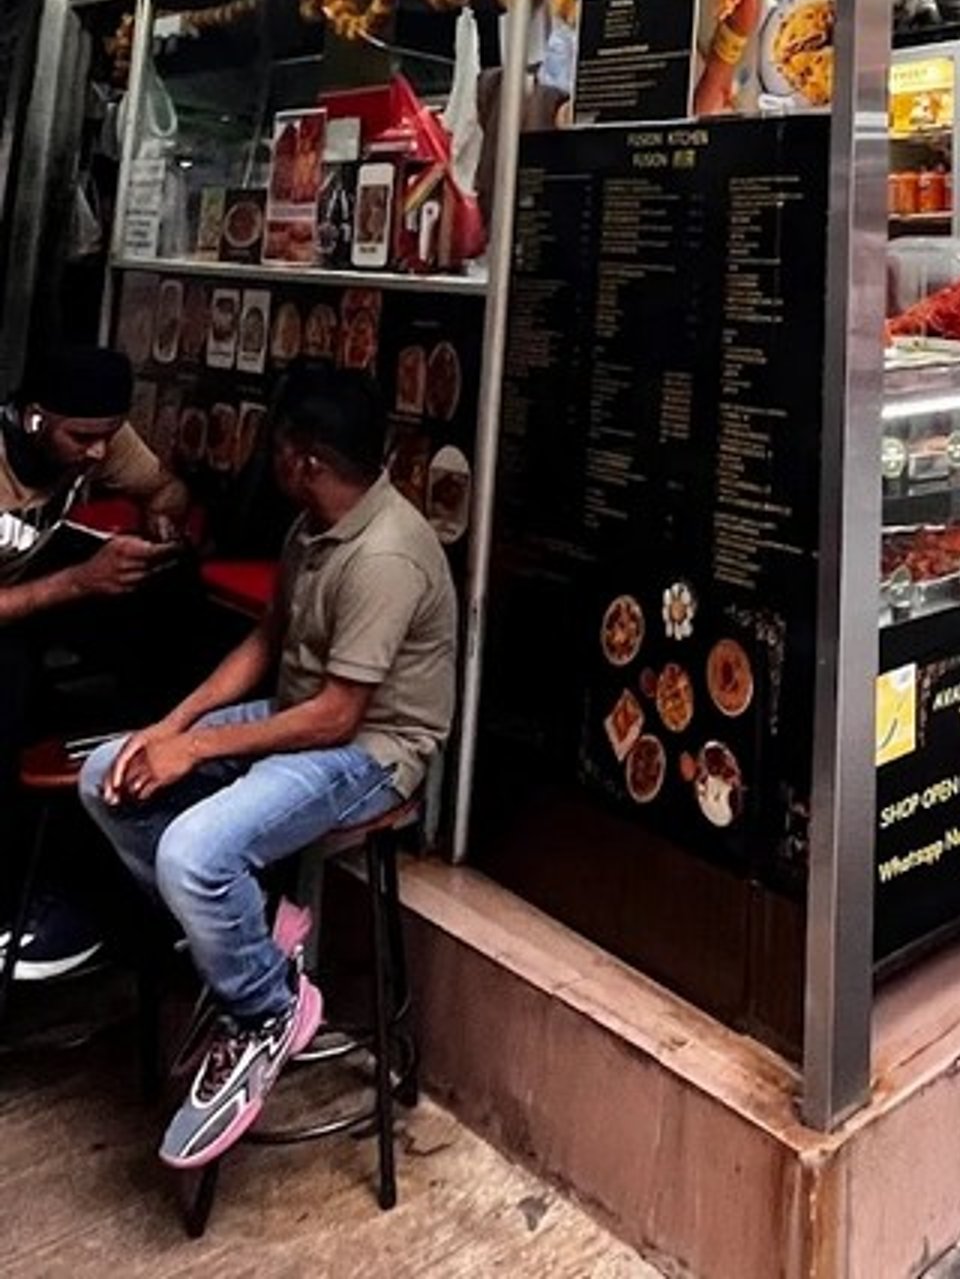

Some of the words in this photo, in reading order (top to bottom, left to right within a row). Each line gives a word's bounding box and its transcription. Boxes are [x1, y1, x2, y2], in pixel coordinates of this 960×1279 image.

[627, 132, 663, 147] FUSION
[668, 130, 709, 146] KITCHEN
[632, 151, 668, 168] FUSION
[879, 791, 920, 829] SHOP
[920, 775, 960, 809] OPEN
[878, 840, 944, 884] Whatsapp
